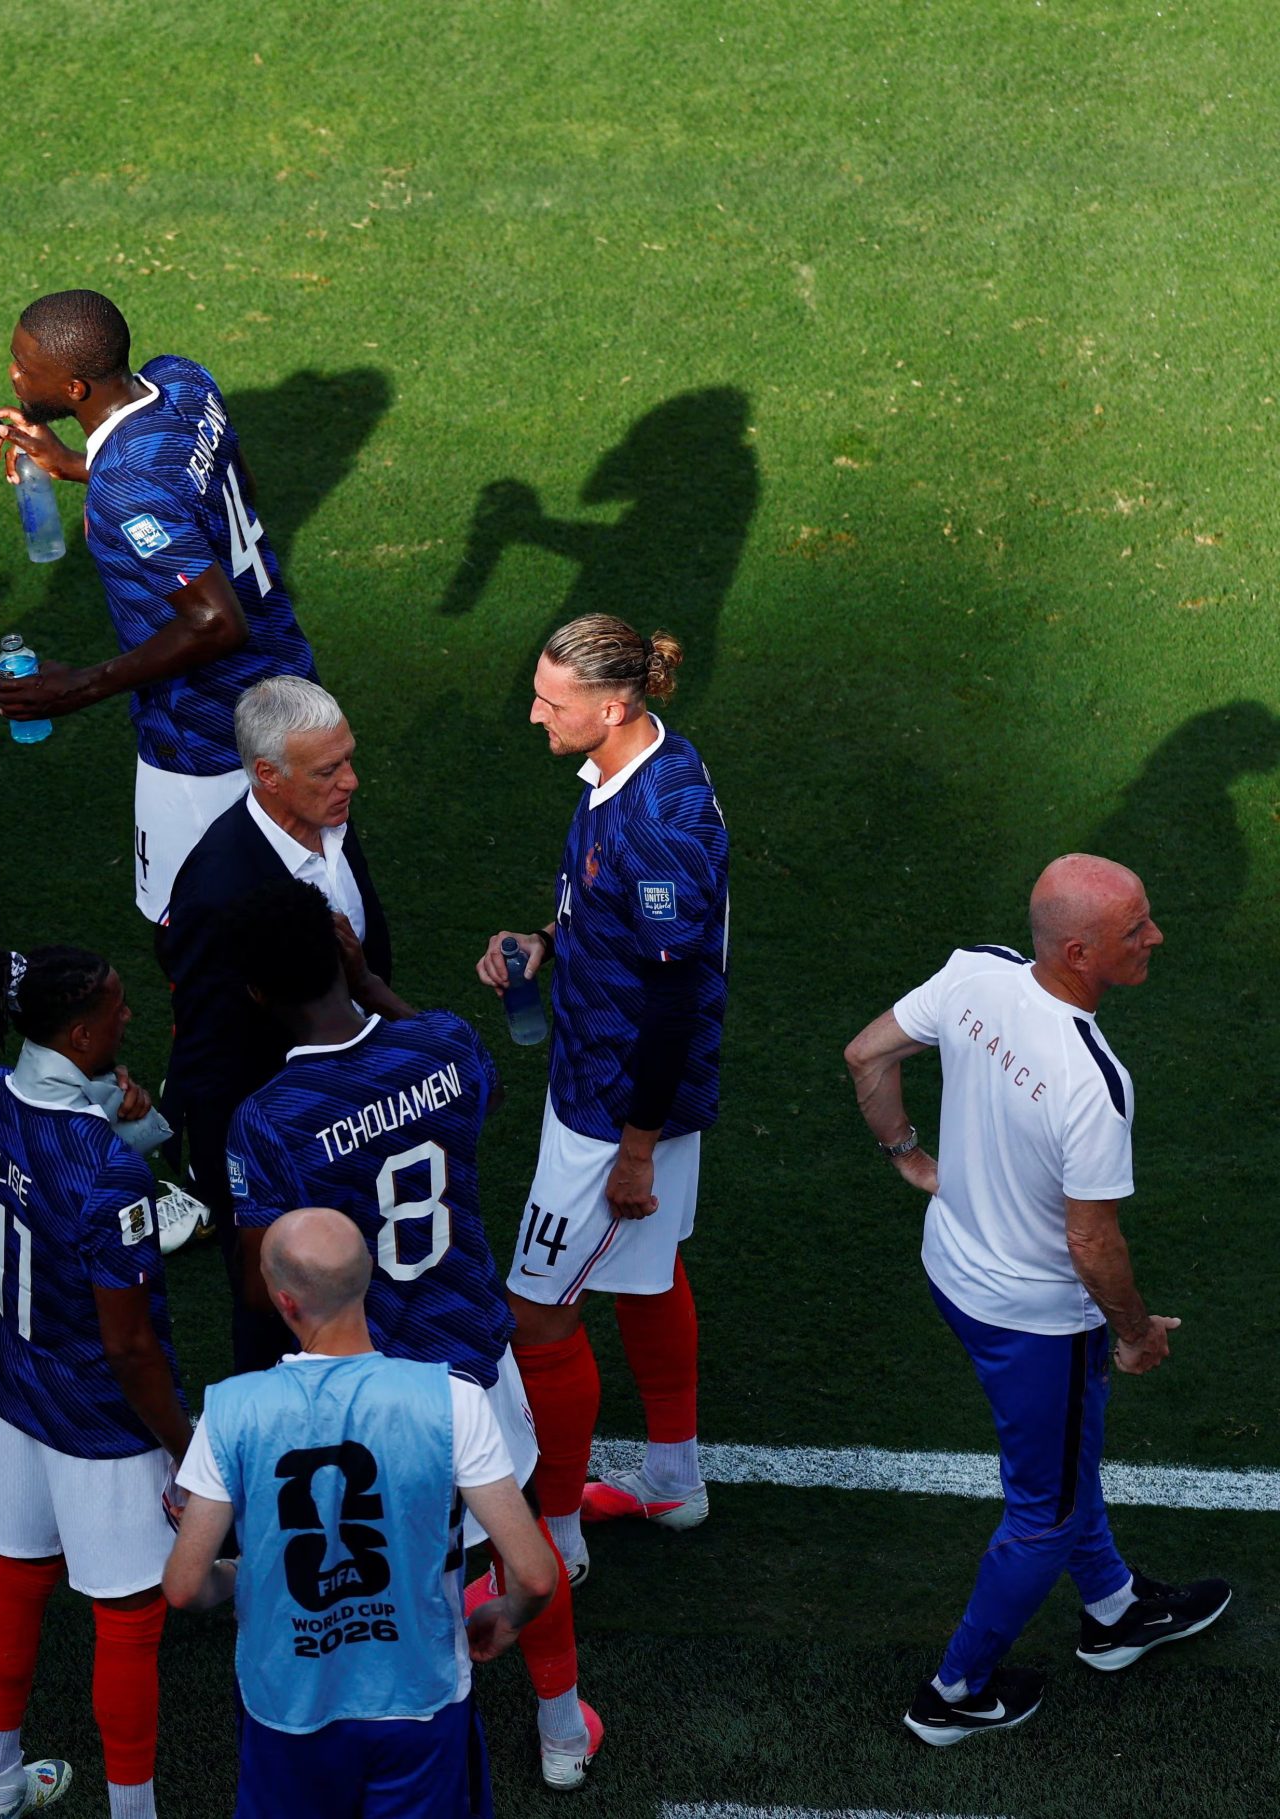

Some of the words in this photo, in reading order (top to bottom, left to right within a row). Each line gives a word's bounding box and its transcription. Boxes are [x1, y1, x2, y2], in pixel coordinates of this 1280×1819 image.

[222, 461, 273, 598] 4
[135, 824, 150, 881] 4
[645, 893, 670, 902] UNITES
[958, 1008, 1047, 1102] FRANCE
[315, 1062, 462, 1163] TCHOUAMENI
[375, 1140, 452, 1281] 8
[522, 1202, 569, 1267] 14
[318, 1566, 363, 1597] FIFA
[291, 1604, 355, 1634] WORLD
[357, 1602, 396, 1618] CUP
[293, 1619, 400, 1659] 2026
